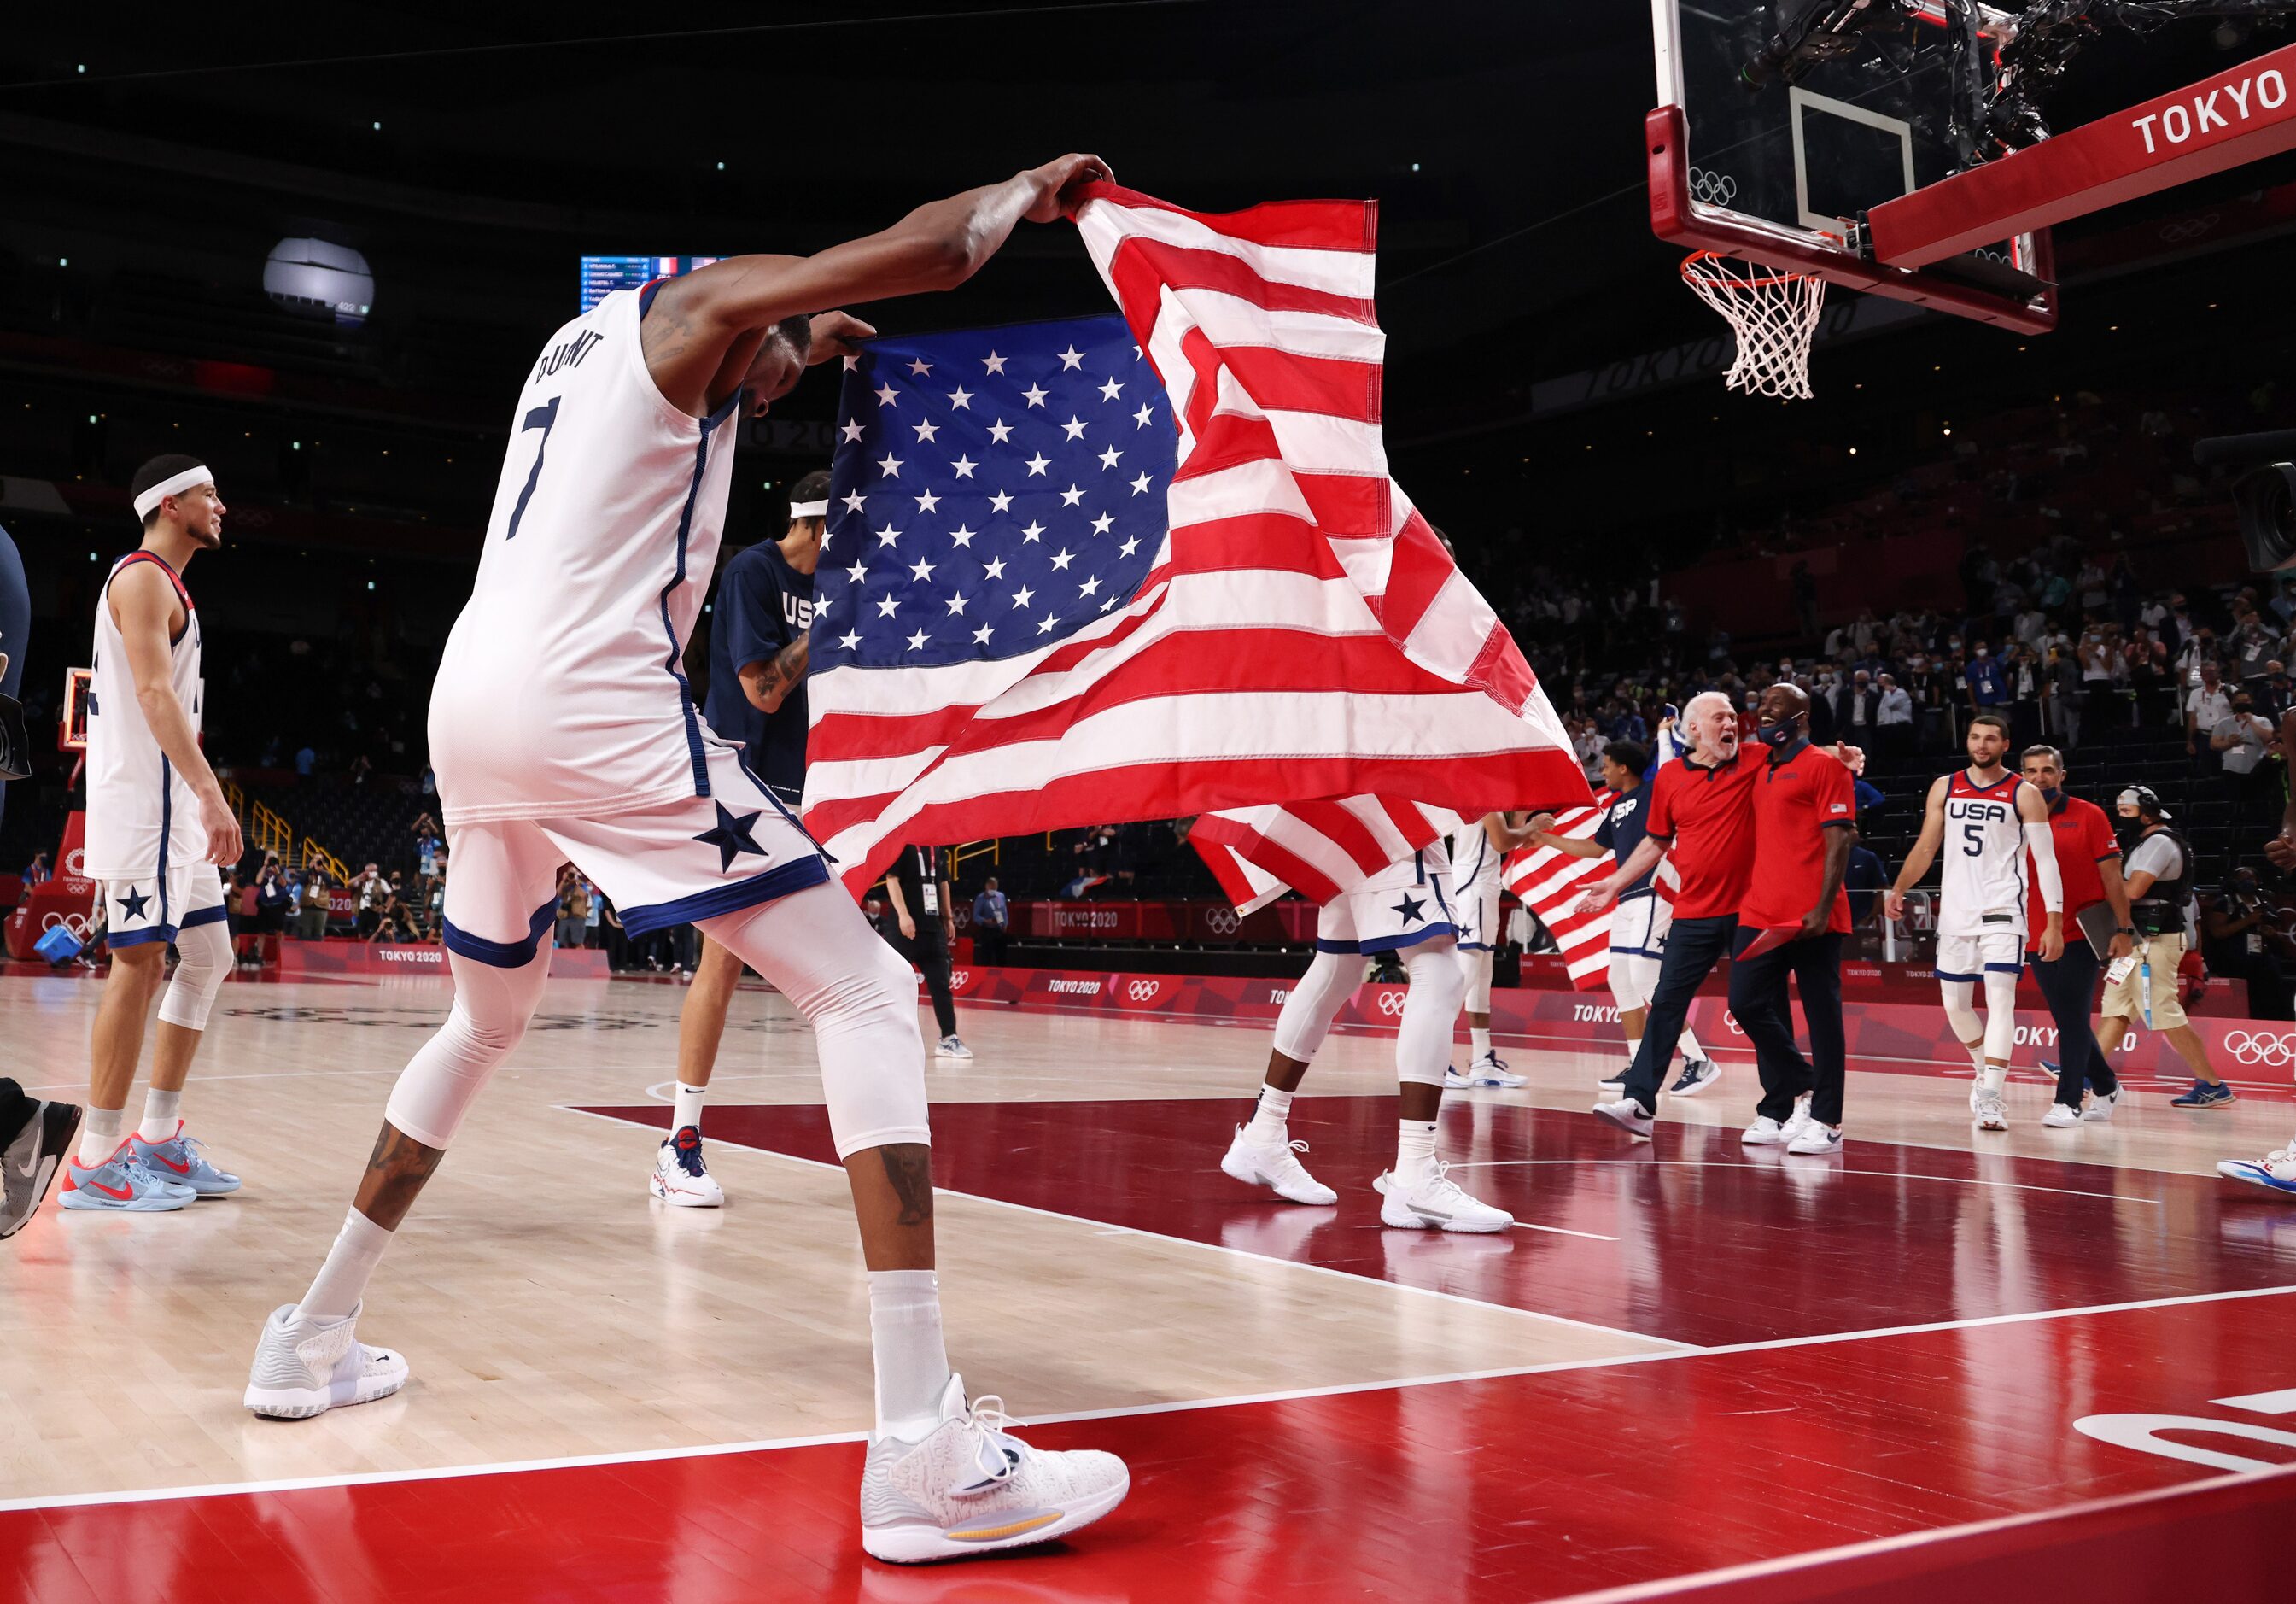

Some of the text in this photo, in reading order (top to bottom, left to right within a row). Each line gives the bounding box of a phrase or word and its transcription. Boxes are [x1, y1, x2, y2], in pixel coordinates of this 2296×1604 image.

[2132, 70, 2287, 154] TOKYO
[506, 395, 561, 540] 7
[783, 591, 813, 629] US
[1950, 802, 2006, 823] USA
[1963, 824, 1984, 857] 5
[1054, 911, 1118, 928] TOKYO 2020
[379, 950, 443, 963] TOKYO 2020
[1048, 979, 1101, 994] TOKYO 2020
[2013, 1026, 2059, 1046] OKY
